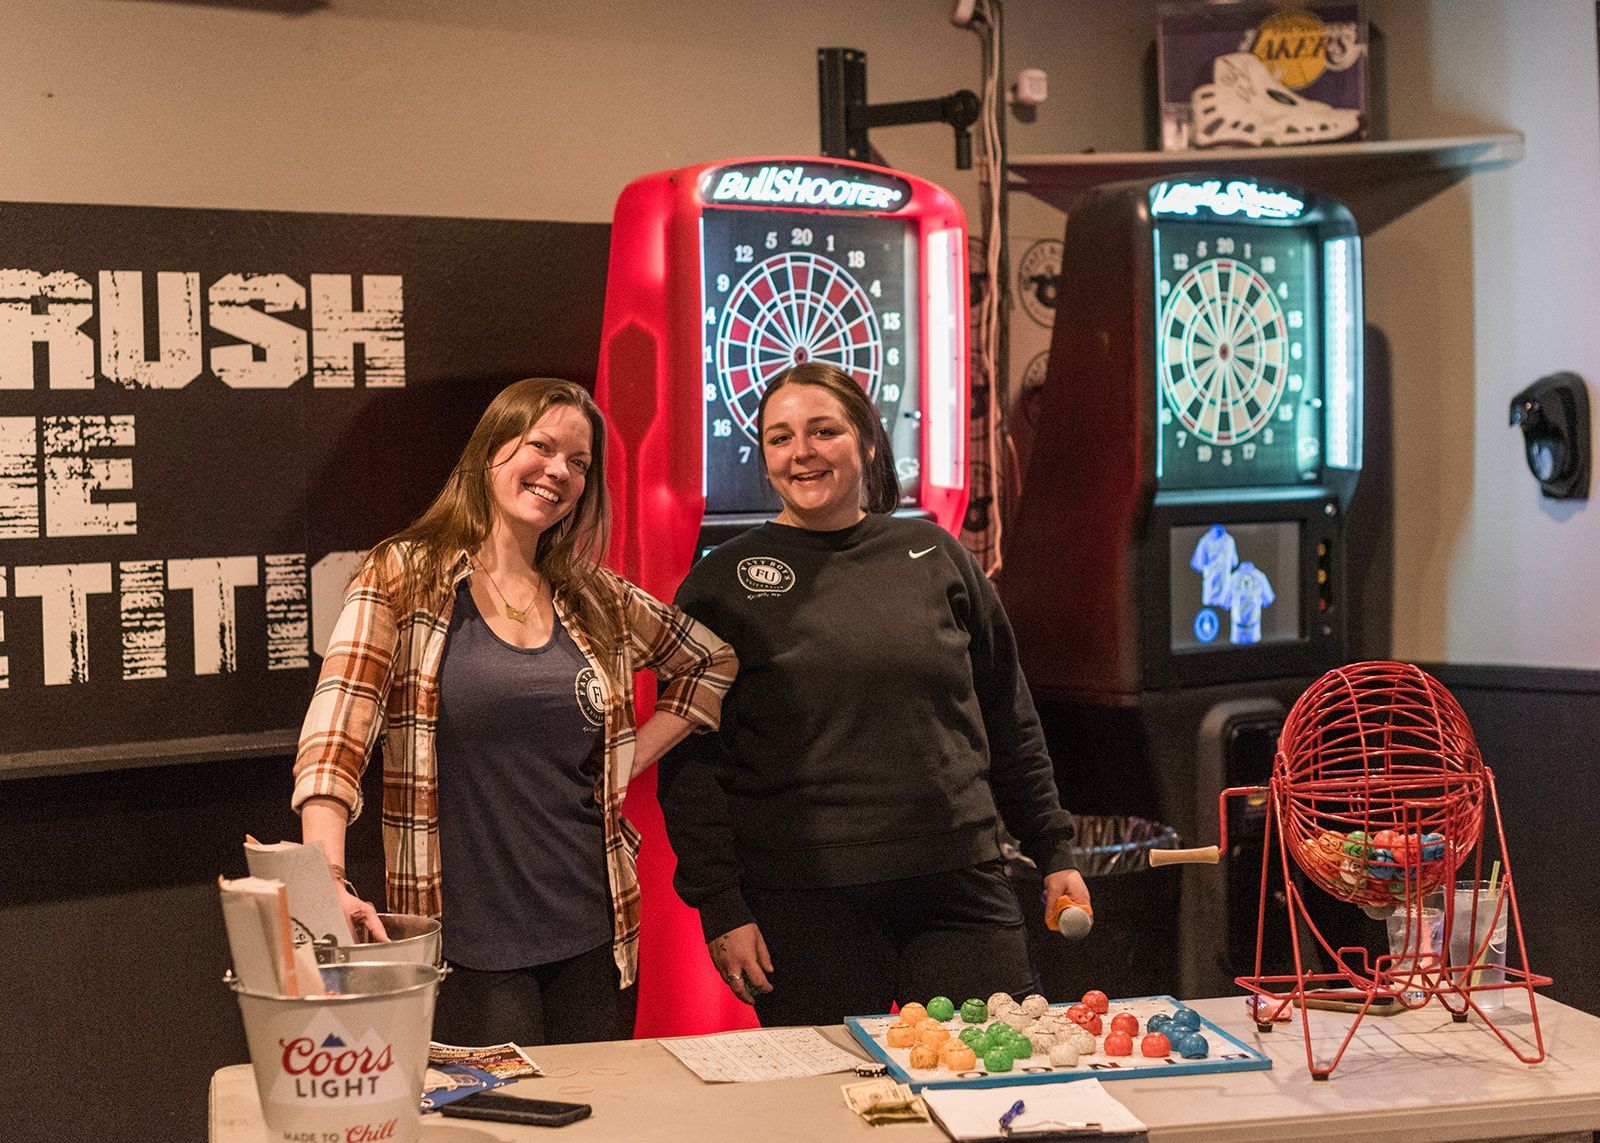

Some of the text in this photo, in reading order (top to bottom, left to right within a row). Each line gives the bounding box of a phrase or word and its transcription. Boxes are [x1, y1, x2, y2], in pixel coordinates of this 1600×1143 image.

[765, 231, 778, 249] 5
[791, 228, 813, 245] 20
[826, 235, 835, 252] 1
[734, 245, 754, 263] 12
[847, 250, 865, 268] 18
[717, 274, 730, 292] 9
[870, 279, 882, 298] 4
[705, 306, 716, 324] 4
[887, 347, 900, 366] 6
[882, 384, 900, 402] 10
[713, 419, 732, 437] 16
[739, 446, 752, 464] 7
[755, 568, 776, 582] FU
[0, 549, 372, 690] TITI
[278, 1037, 395, 1076] Coors
[295, 1075, 379, 1099] LIGHT
[322, 1132, 340, 1143] TO
[344, 1118, 398, 1143] Chill
